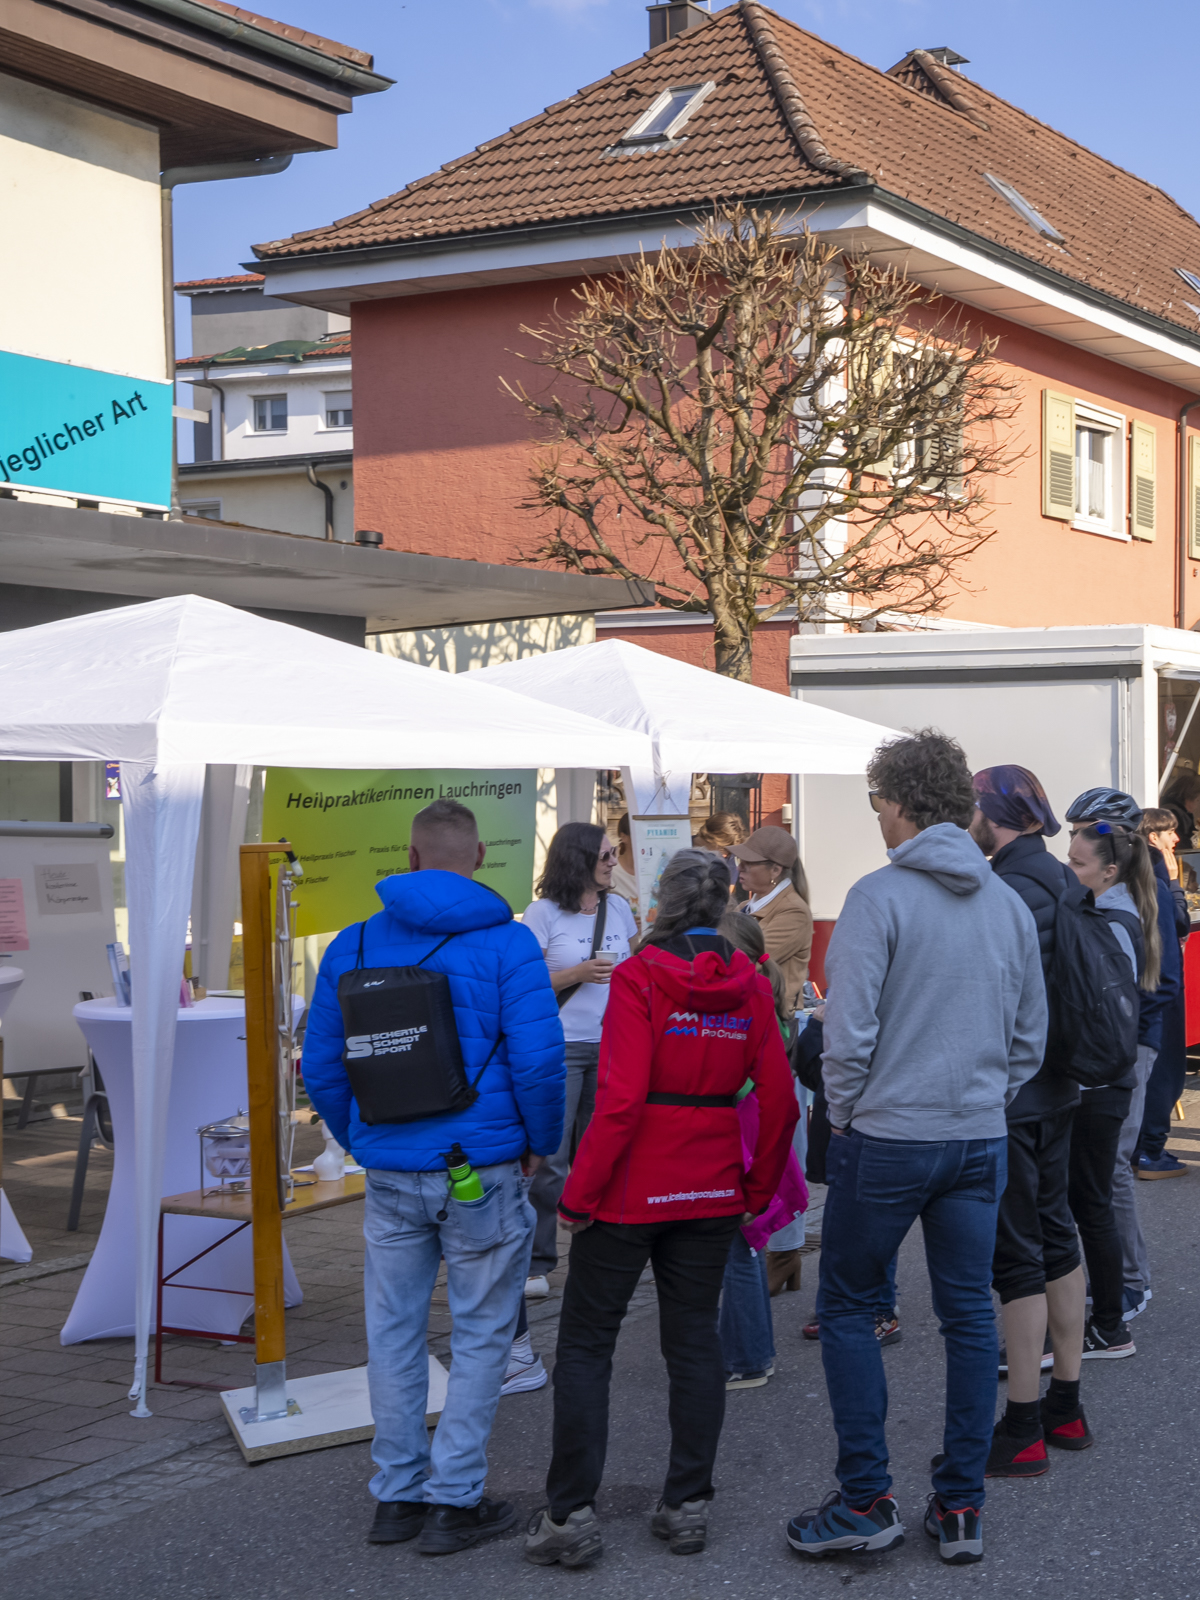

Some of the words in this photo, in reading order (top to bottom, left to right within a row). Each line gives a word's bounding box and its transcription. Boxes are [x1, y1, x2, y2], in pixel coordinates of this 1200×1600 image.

[0, 412, 105, 482] jeglicher
[111, 390, 148, 425] Art
[286, 785, 434, 812] Heilpraktikerinnen
[439, 780, 522, 799] Lauchringen
[300, 852, 334, 863] Heilpraxis
[335, 849, 357, 858] Fischer
[369, 846, 390, 854] Praxis
[391, 844, 401, 852] für
[305, 875, 329, 884] Fischer
[578, 934, 620, 944] woen
[702, 1013, 753, 1031] Iceland
[371, 1025, 428, 1041] SCHERTLE
[373, 1034, 420, 1048] SCHMIDT
[374, 1043, 412, 1056] SPORT
